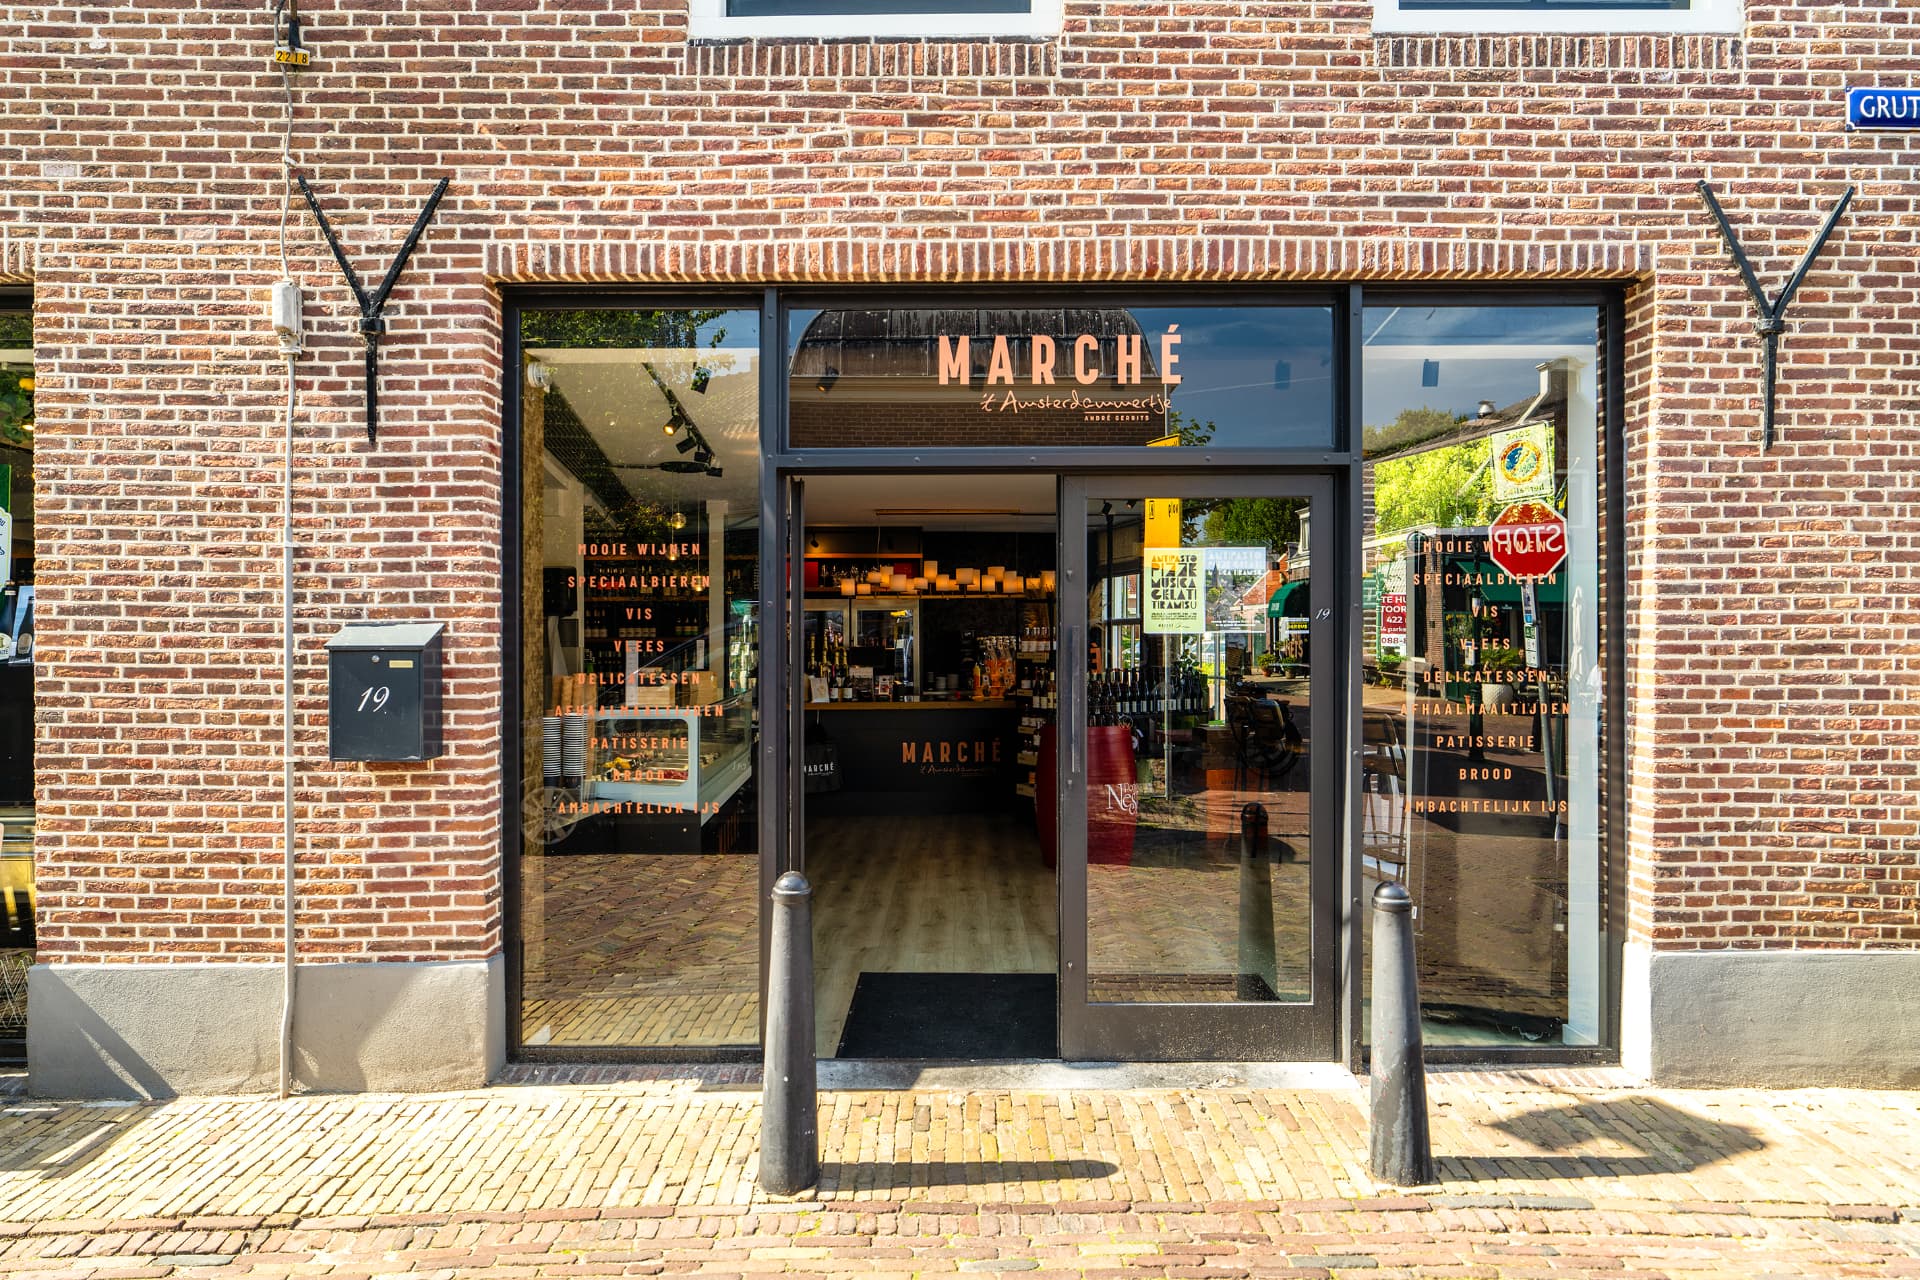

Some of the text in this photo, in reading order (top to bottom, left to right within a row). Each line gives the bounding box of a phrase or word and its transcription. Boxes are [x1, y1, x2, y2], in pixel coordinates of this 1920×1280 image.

[276, 50, 308, 64] 2218
[1860, 95, 1920, 119] GRUT
[938, 324, 1182, 385] MARCHÉ
[1000, 389, 1173, 415] Amsterdammertje
[1084, 414, 1111, 422] ANDRÉ
[578, 543, 700, 556] MOOIE WIJNEN
[1423, 540, 1546, 553] MOOIE WIJNEN
[1151, 563, 1197, 577] PIZZE
[568, 575, 711, 588] SPECIAALBIEREN
[1151, 577, 1196, 588] MUSICA
[1413, 573, 1557, 585] SPECIAALBIEREN
[1151, 589, 1197, 601] GELATI
[1152, 601, 1197, 609] TIRAMISU
[1471, 605, 1498, 618] VIS
[626, 608, 653, 620] VIS
[1315, 608, 1331, 620] 19
[1386, 616, 1403, 624] 422
[614, 640, 664, 652] VLEES
[1460, 638, 1510, 650] VLEES
[578, 672, 700, 685] DELICATESSEN
[1423, 670, 1547, 683] DELICATESSEN
[357, 686, 390, 713] 19
[555, 705, 724, 717] AFHAALMAALTIJDEN
[1400, 703, 1571, 715] AFHAALMAALTIJDEN
[590, 737, 688, 749] PATISSERIE
[1436, 735, 1535, 748] PATISSERIE
[902, 737, 1001, 763] MARCHÉ
[613, 770, 665, 782] BROOD
[1459, 768, 1512, 780] BROOD
[558, 801, 720, 814] AMBACHTELIJK IJS
[1403, 800, 1568, 813] AMBACHTELIJK IJS
